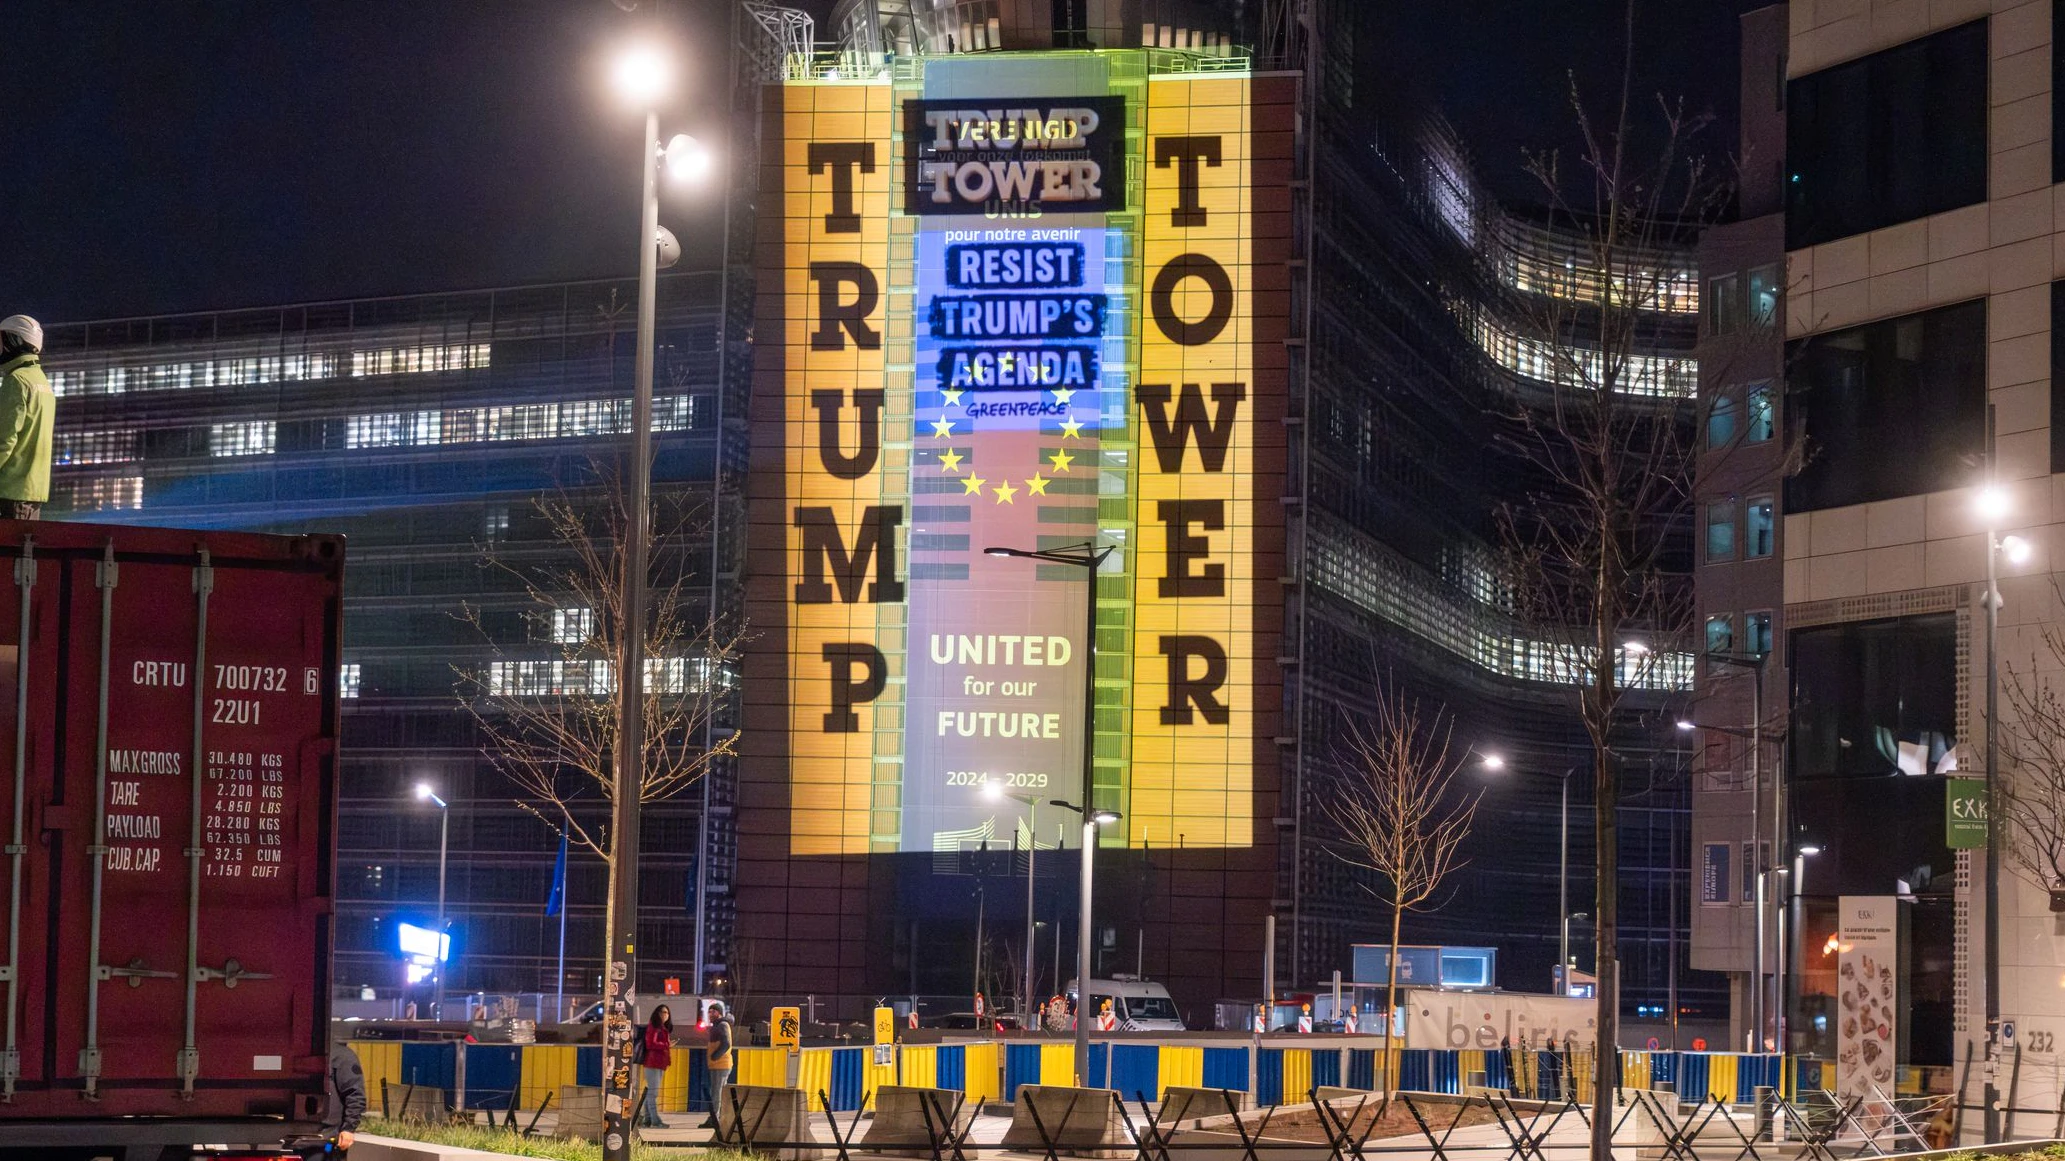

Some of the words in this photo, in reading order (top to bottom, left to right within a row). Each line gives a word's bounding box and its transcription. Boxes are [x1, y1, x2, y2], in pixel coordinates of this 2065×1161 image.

[925, 108, 1099, 150] TRUMP
[925, 161, 1102, 203] TOWER
[984, 199, 1043, 219] UNIS
[945, 229, 980, 244] pour
[985, 228, 1026, 241] notre
[1031, 227, 1081, 241] avenir
[960, 248, 1074, 284] RESIST
[941, 299, 1094, 335] TRUMP’S
[951, 351, 1085, 387] AGENDA
[965, 401, 1069, 419] GREENPEACE
[794, 142, 904, 733] TRUMP
[1135, 136, 1246, 726] TOWER
[930, 634, 1072, 666] UNITED
[133, 660, 186, 687] CRTU
[214, 665, 287, 692] 700732
[963, 675, 995, 696] for
[1001, 681, 1038, 697] our
[212, 699, 260, 725] 22U1
[938, 711, 1060, 739] FUTURE
[209, 751, 252, 766] 30.480
[261, 754, 283, 767] KGS
[262, 770, 283, 782] LBS
[946, 771, 988, 787] 2024
[1005, 772, 1049, 788] 2029
[111, 782, 140, 806] TARE
[217, 784, 253, 797] 2.200
[262, 785, 283, 798] KGS
[215, 800, 252, 813] 4.850
[260, 802, 282, 814] LBS
[1953, 798, 1988, 818] EXK
[108, 814, 160, 839] PAYLOAD
[207, 816, 250, 829] 28.280
[259, 817, 280, 830] KGS
[260, 834, 281, 845] LBS
[215, 848, 243, 861] 32.5
[257, 849, 281, 862] CUM
[207, 864, 242, 877] 1.150
[252, 865, 280, 878] CUFT
[2028, 1031, 2053, 1053] 232
